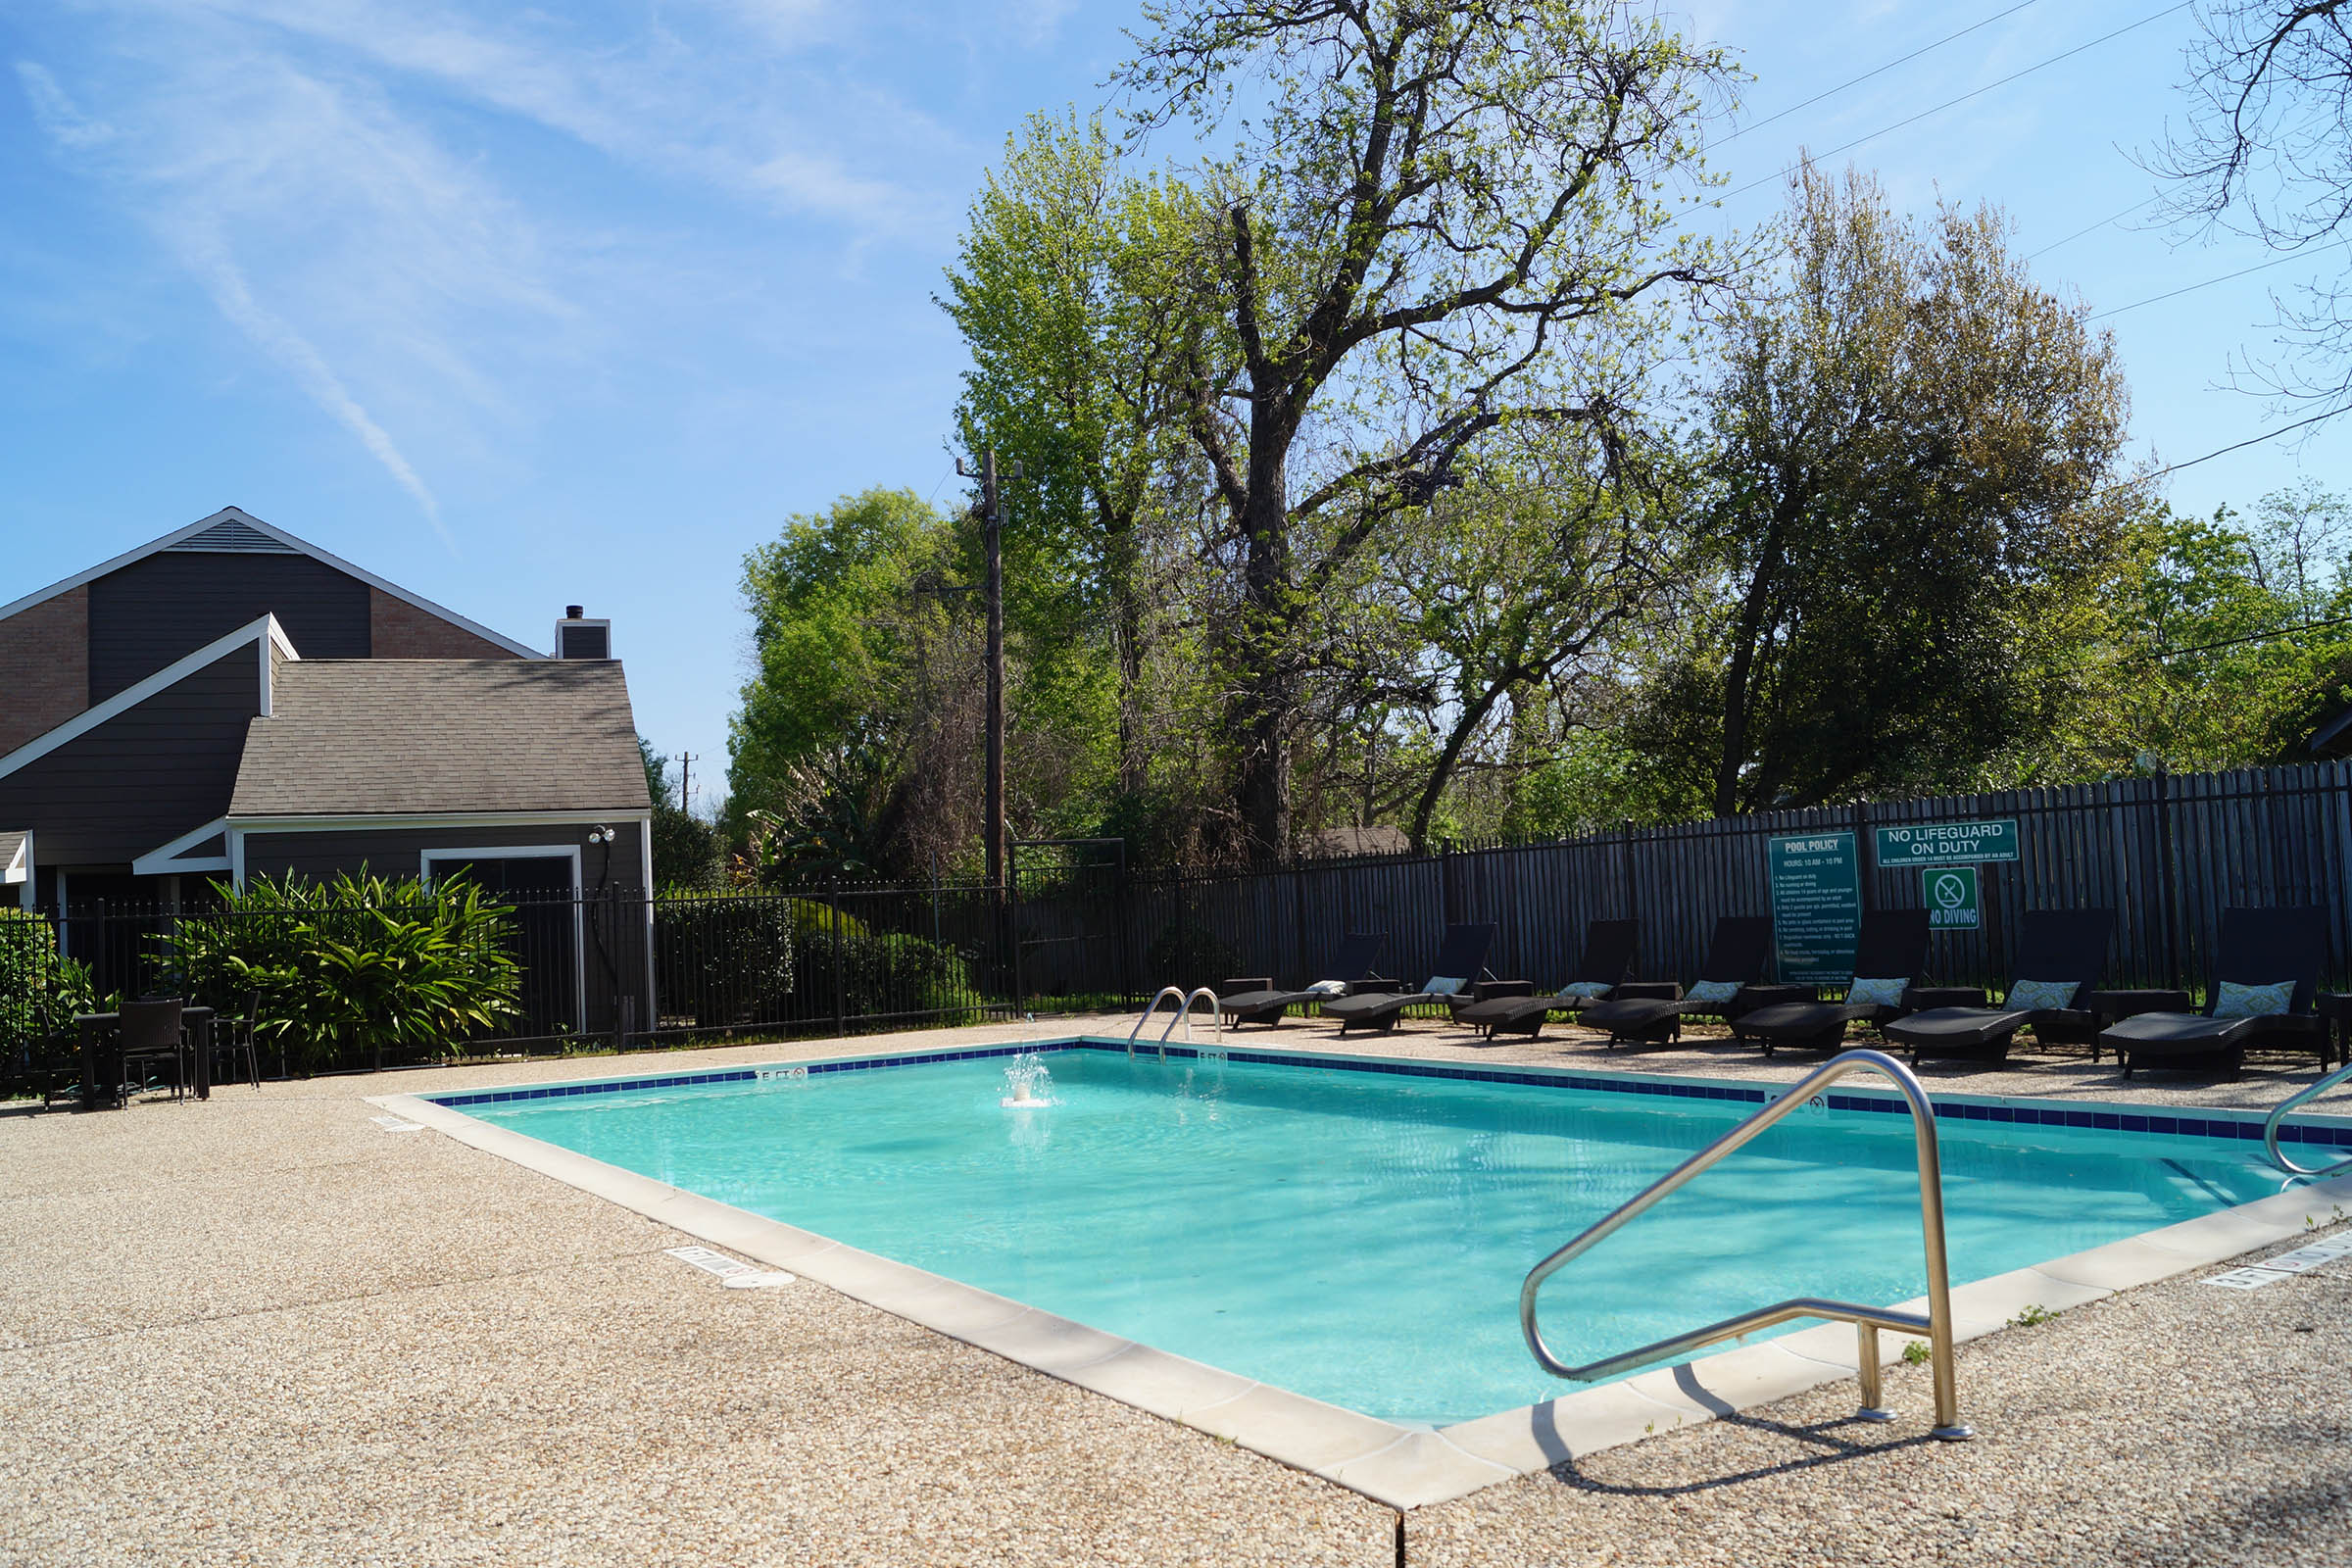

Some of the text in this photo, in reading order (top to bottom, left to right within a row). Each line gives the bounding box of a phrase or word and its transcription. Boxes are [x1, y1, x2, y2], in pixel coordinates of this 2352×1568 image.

[1889, 824, 2003, 843] NO LIFEGUARD
[1785, 839, 1838, 853] POOL POLICY
[1911, 840, 1980, 855] ON DUTY
[1783, 859, 1803, 867] HOURS:
[1929, 908, 1976, 924] NO DIVING
